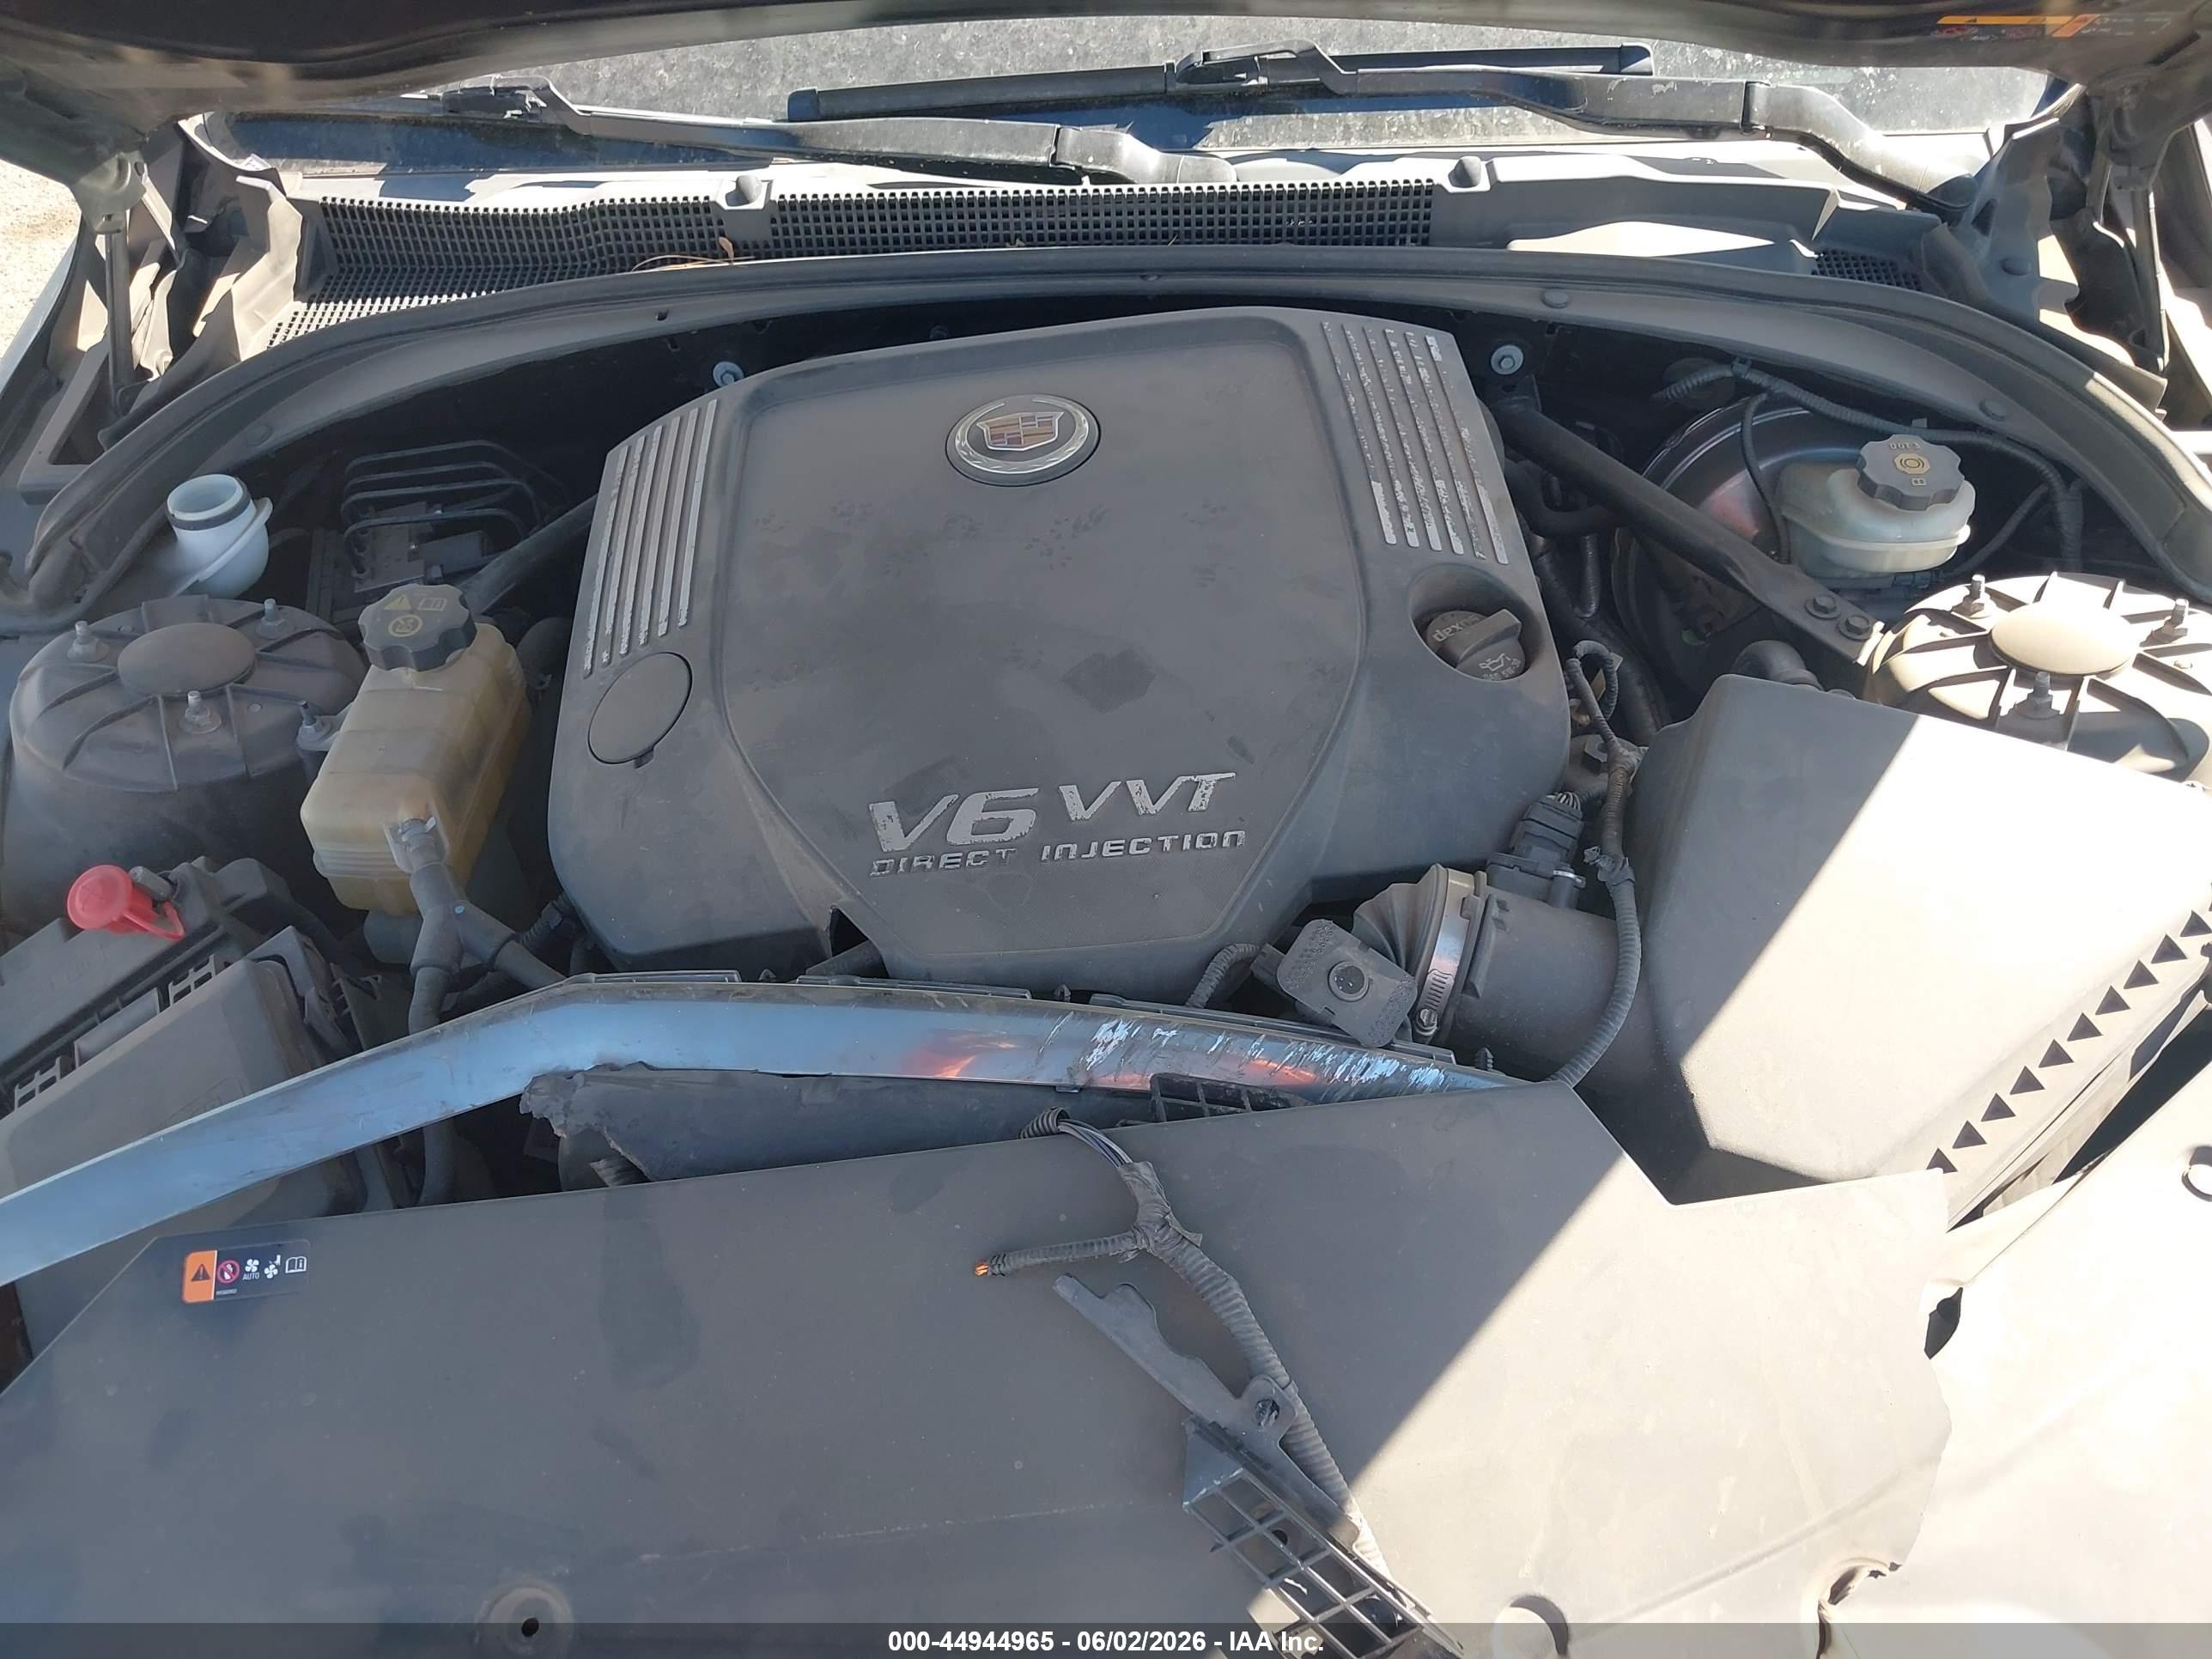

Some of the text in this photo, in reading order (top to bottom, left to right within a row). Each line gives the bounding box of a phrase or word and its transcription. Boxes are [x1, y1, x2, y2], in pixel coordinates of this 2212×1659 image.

[869, 772, 1237, 853] V6 VVT
[870, 830, 1246, 878] DIRECT INJECTION
[242, 1272, 260, 1280] AUTO
